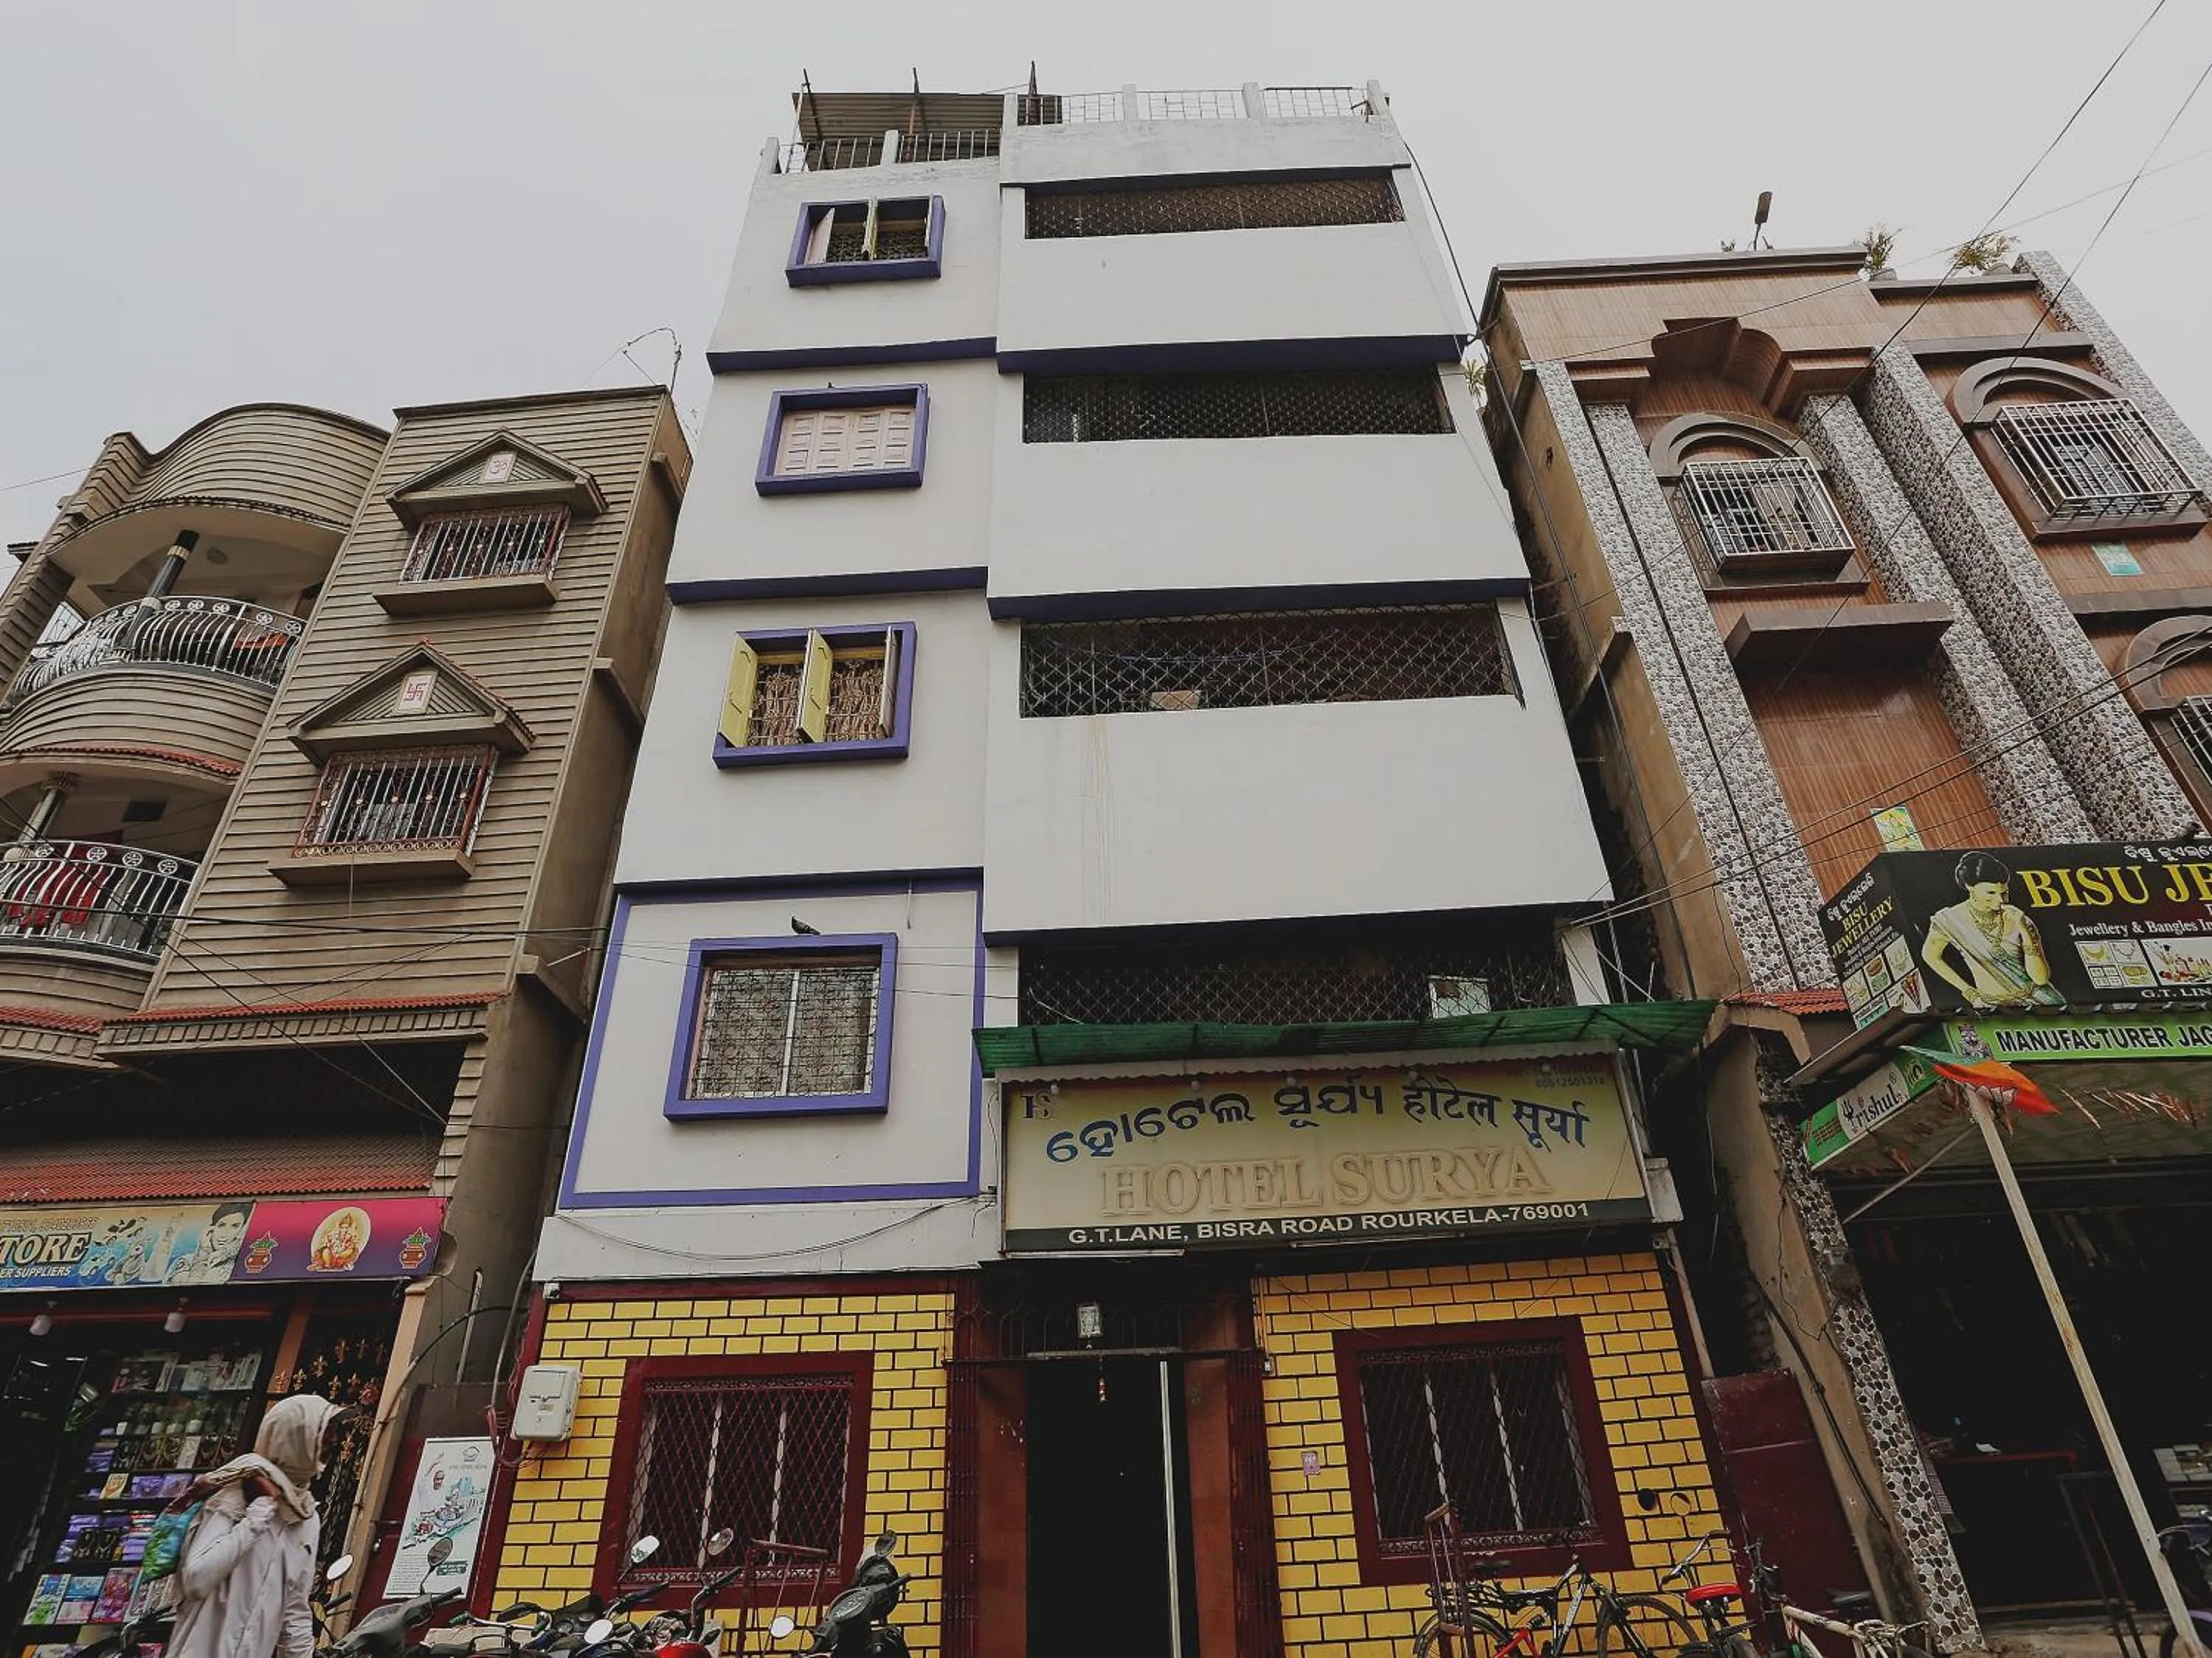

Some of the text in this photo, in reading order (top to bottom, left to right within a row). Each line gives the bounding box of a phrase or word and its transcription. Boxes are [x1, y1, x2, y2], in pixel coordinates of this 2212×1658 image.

[2016, 865, 2149, 908] BISU
[1831, 895, 1894, 958] JEWELLERY
[1843, 901, 1868, 932] BISU
[2068, 922, 2128, 937] Jewellery
[2132, 921, 2145, 933] &
[2146, 920, 2198, 935] Bangles
[1995, 1025, 2174, 1052] MANUFACTURER
[1046, 1093, 1256, 1163] ହୋଟେଲ
[1511, 1100, 1590, 1153] सूर्या
[1100, 1143, 1554, 1216] HOTEL SURYA
[1068, 1203, 1590, 1244] G.T.LANE, BISRA ROAD ROURKELA-769001
[14, 1266, 72, 1278] SUPPLIERS
